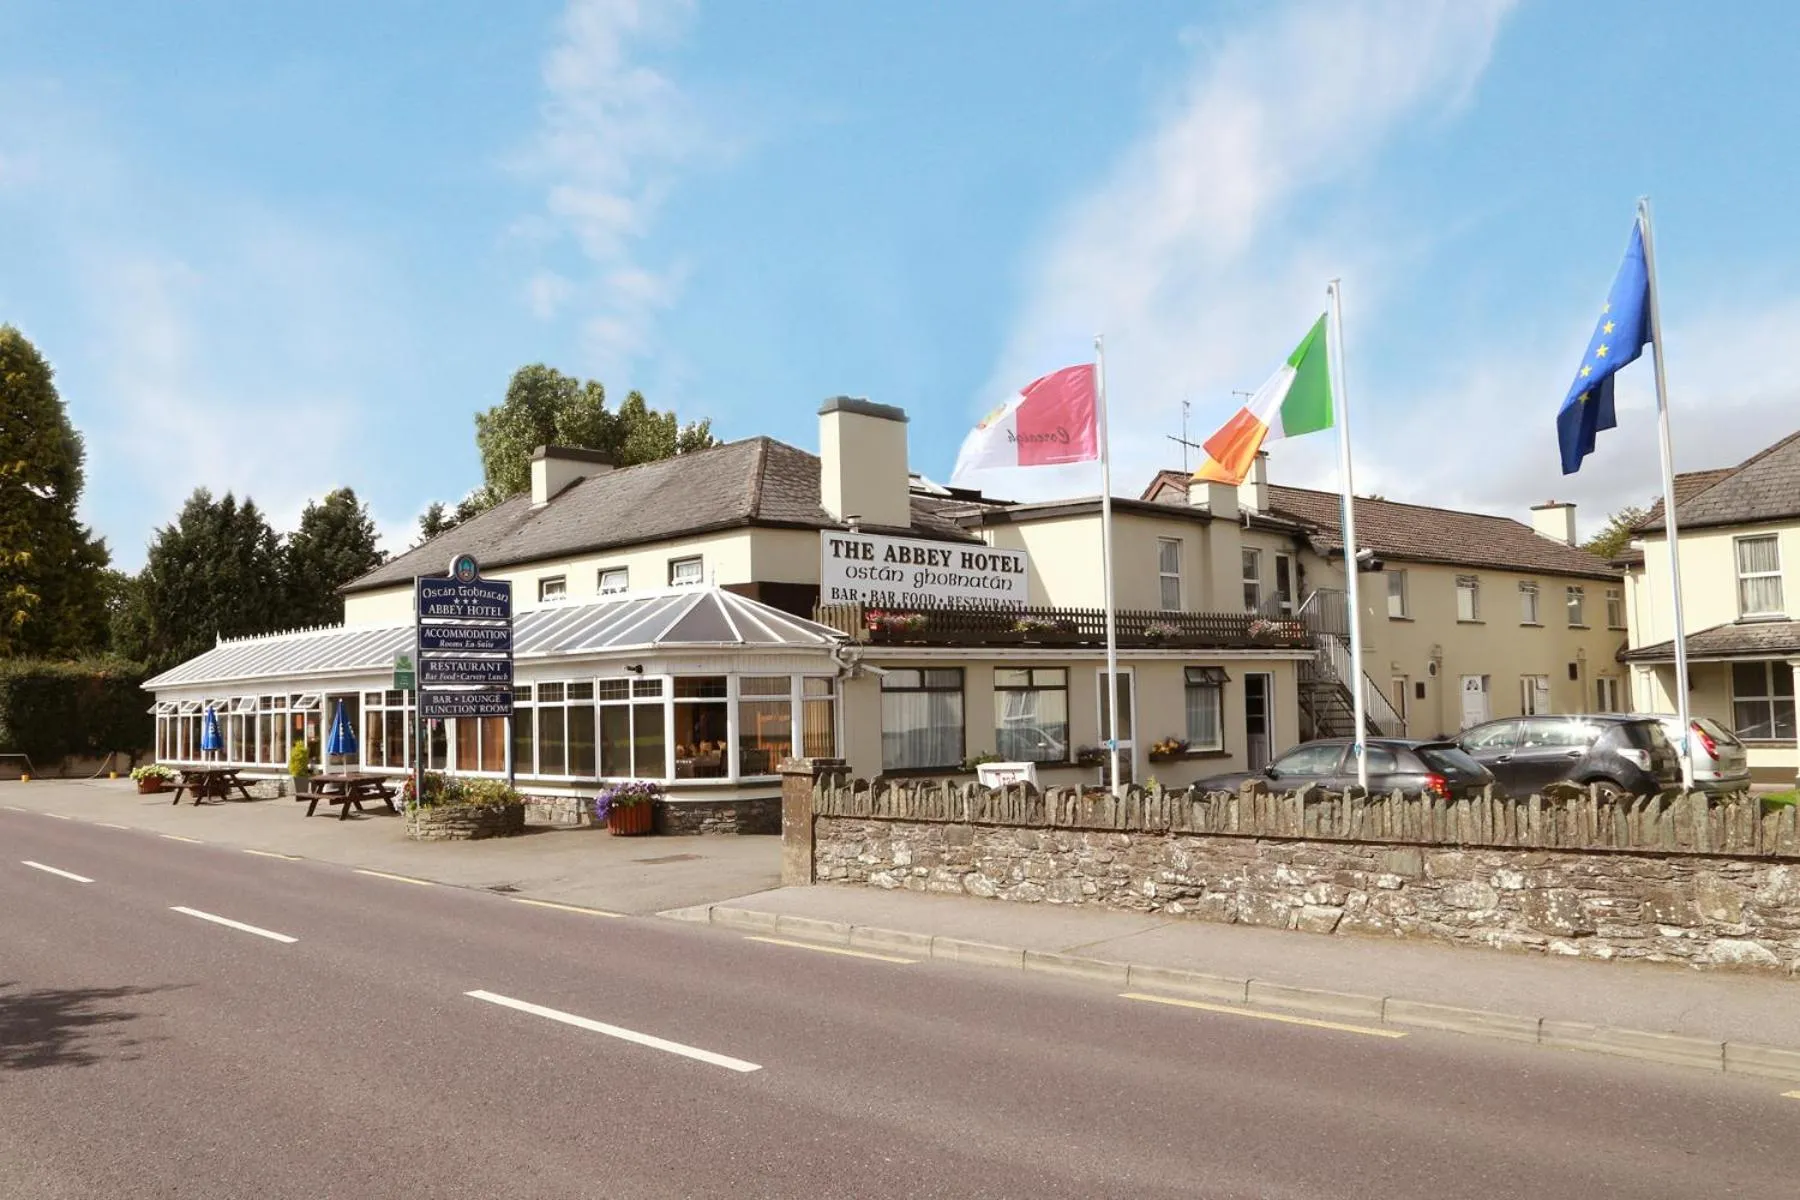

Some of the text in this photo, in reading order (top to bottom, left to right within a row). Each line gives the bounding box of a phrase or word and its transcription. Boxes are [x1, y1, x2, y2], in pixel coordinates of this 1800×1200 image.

[829, 539, 1024, 574] THE ABBEY HOTEL
[831, 587, 1024, 609] BAR BAR FOOD RESTAURANT
[428, 604, 504, 617] ABBEY HOTEL
[424, 628, 507, 640] ACCOMMODATION
[439, 639, 463, 648] Rooms
[430, 661, 503, 671] RESTAURANT
[424, 672, 438, 681] Bar
[487, 671, 509, 681] Lunch
[432, 695, 501, 704] BAR LOUNGE
[425, 704, 509, 715] FUNCTION ROOM
